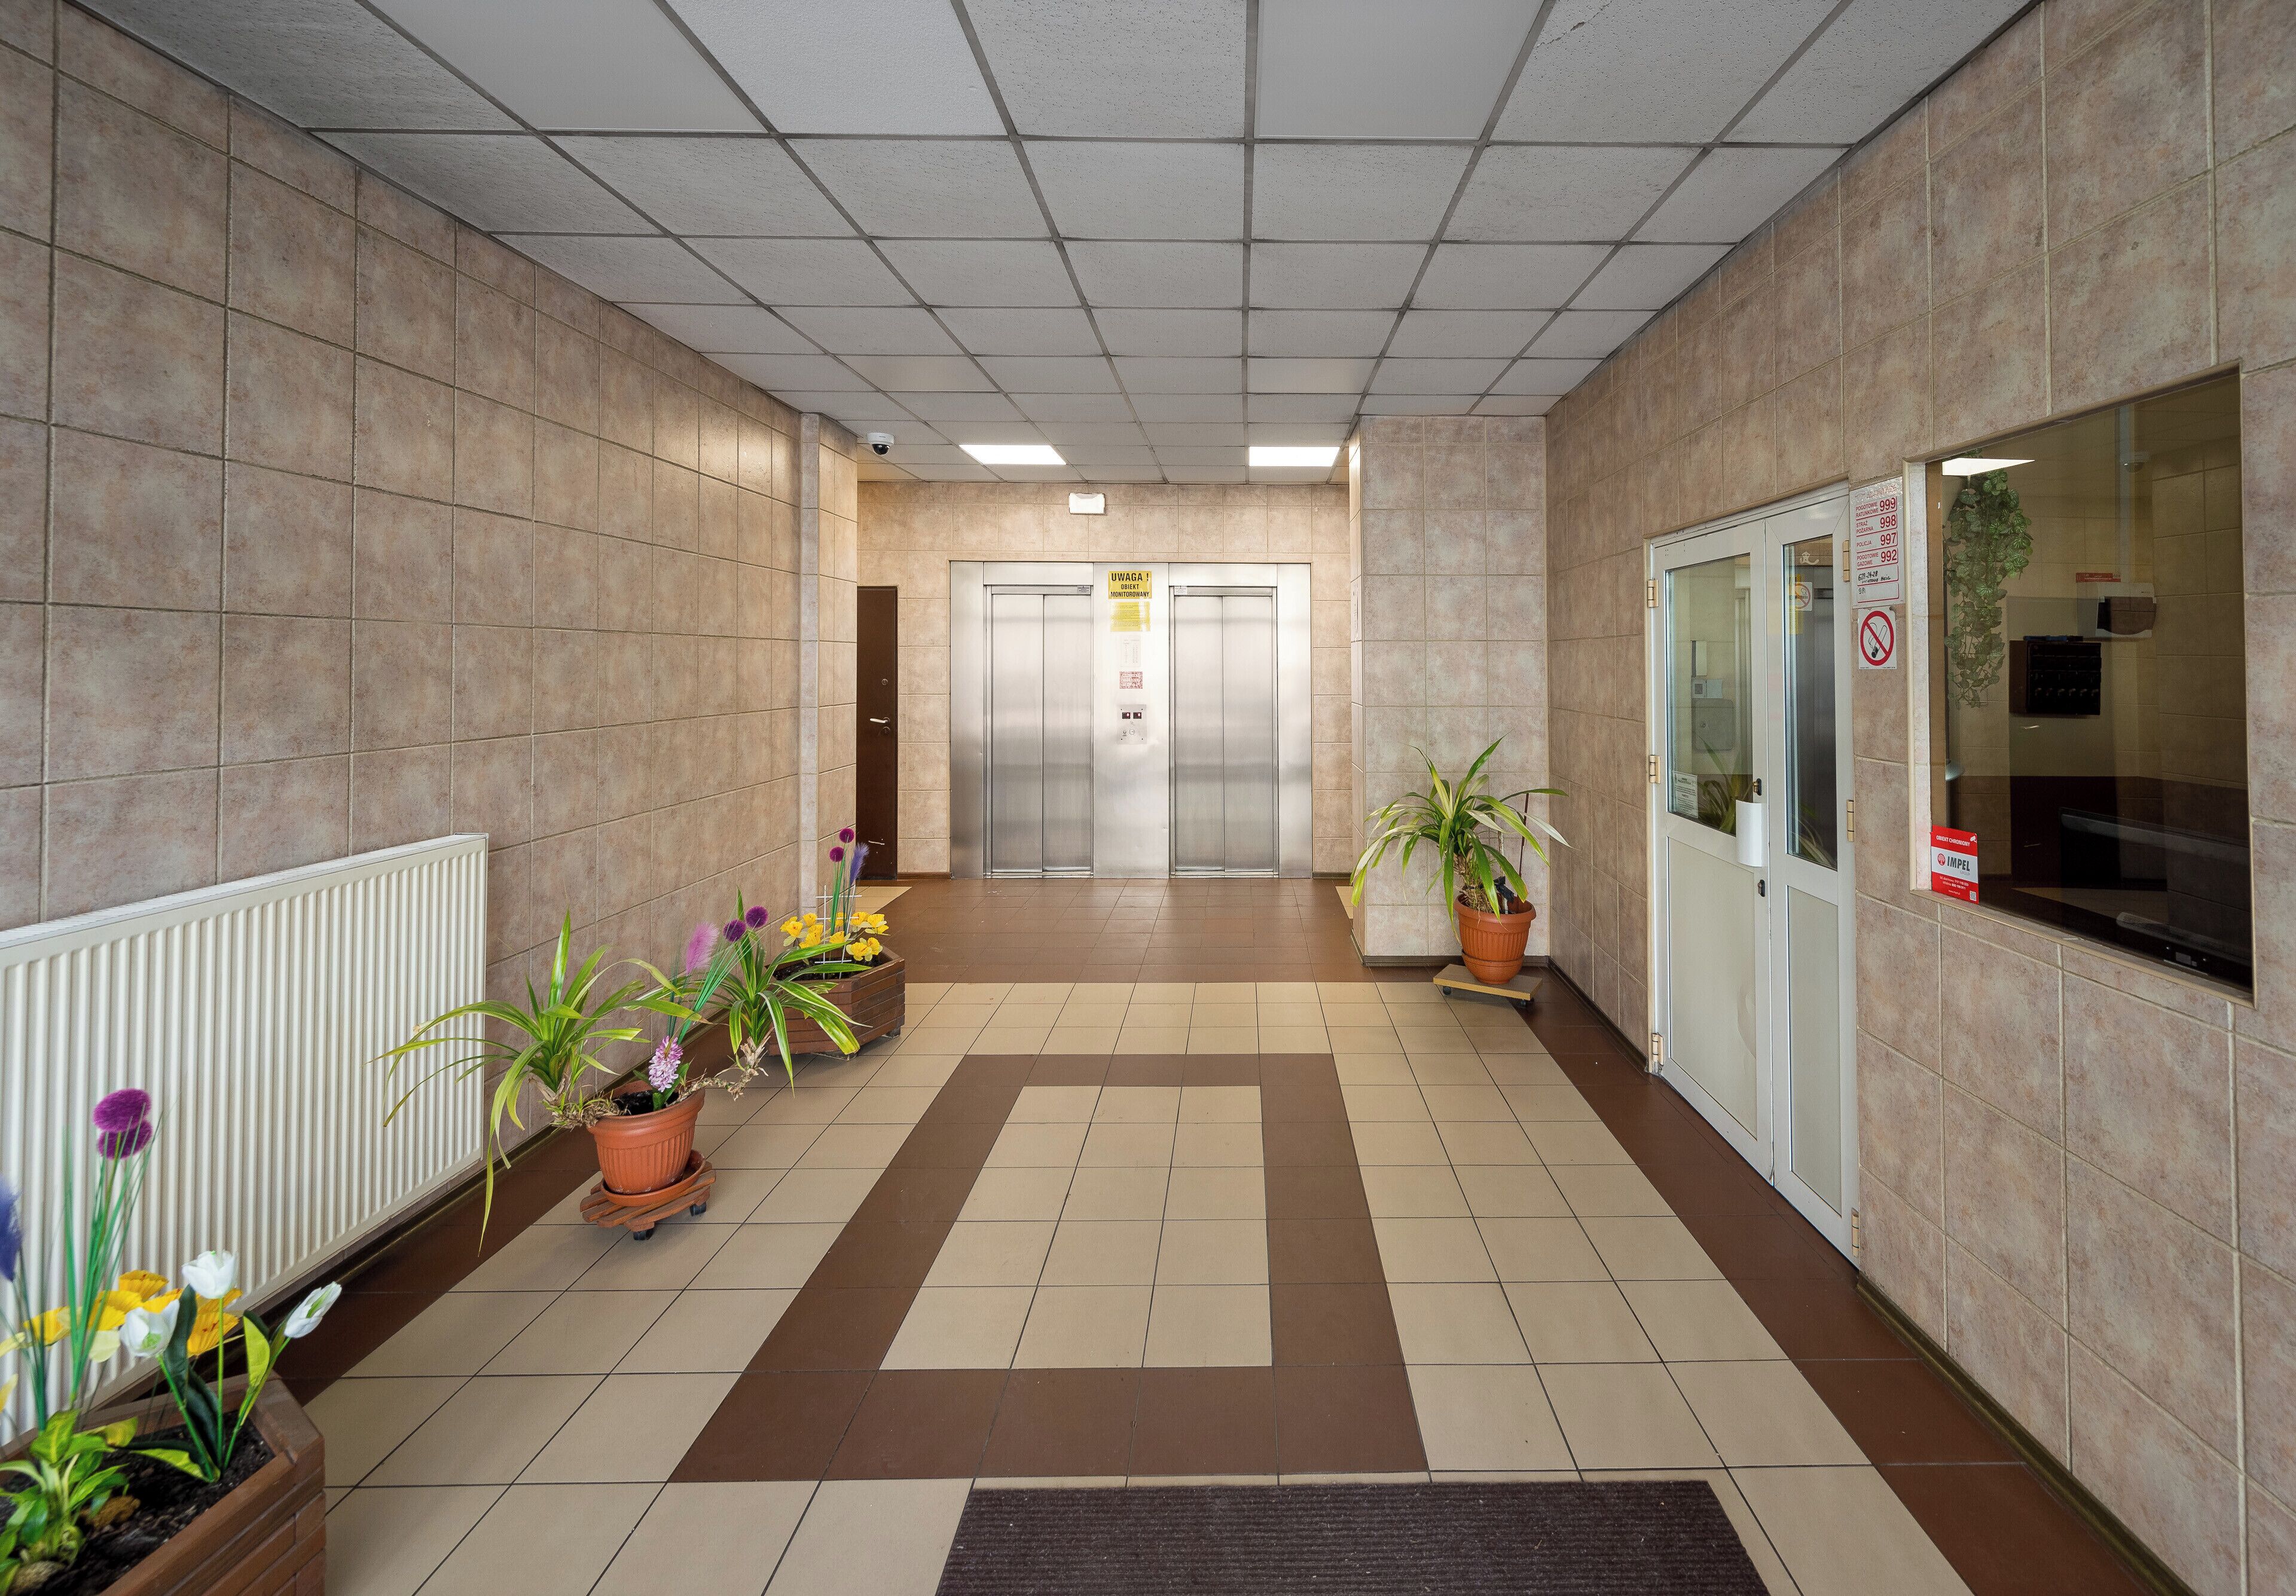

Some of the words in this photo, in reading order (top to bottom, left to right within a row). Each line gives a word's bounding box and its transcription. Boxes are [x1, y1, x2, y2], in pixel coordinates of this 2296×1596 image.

[1856, 502, 1877, 511] POGOTOWIE
[1879, 497, 1895, 512] 999
[1856, 507, 1879, 518] RATUNKOWE
[1880, 515, 1896, 528] 998
[1880, 532, 1896, 546] 997
[1880, 549, 1897, 562] 992
[1111, 573, 1143, 581] UWAGA
[1947, 856, 1970, 872] IMPEL
